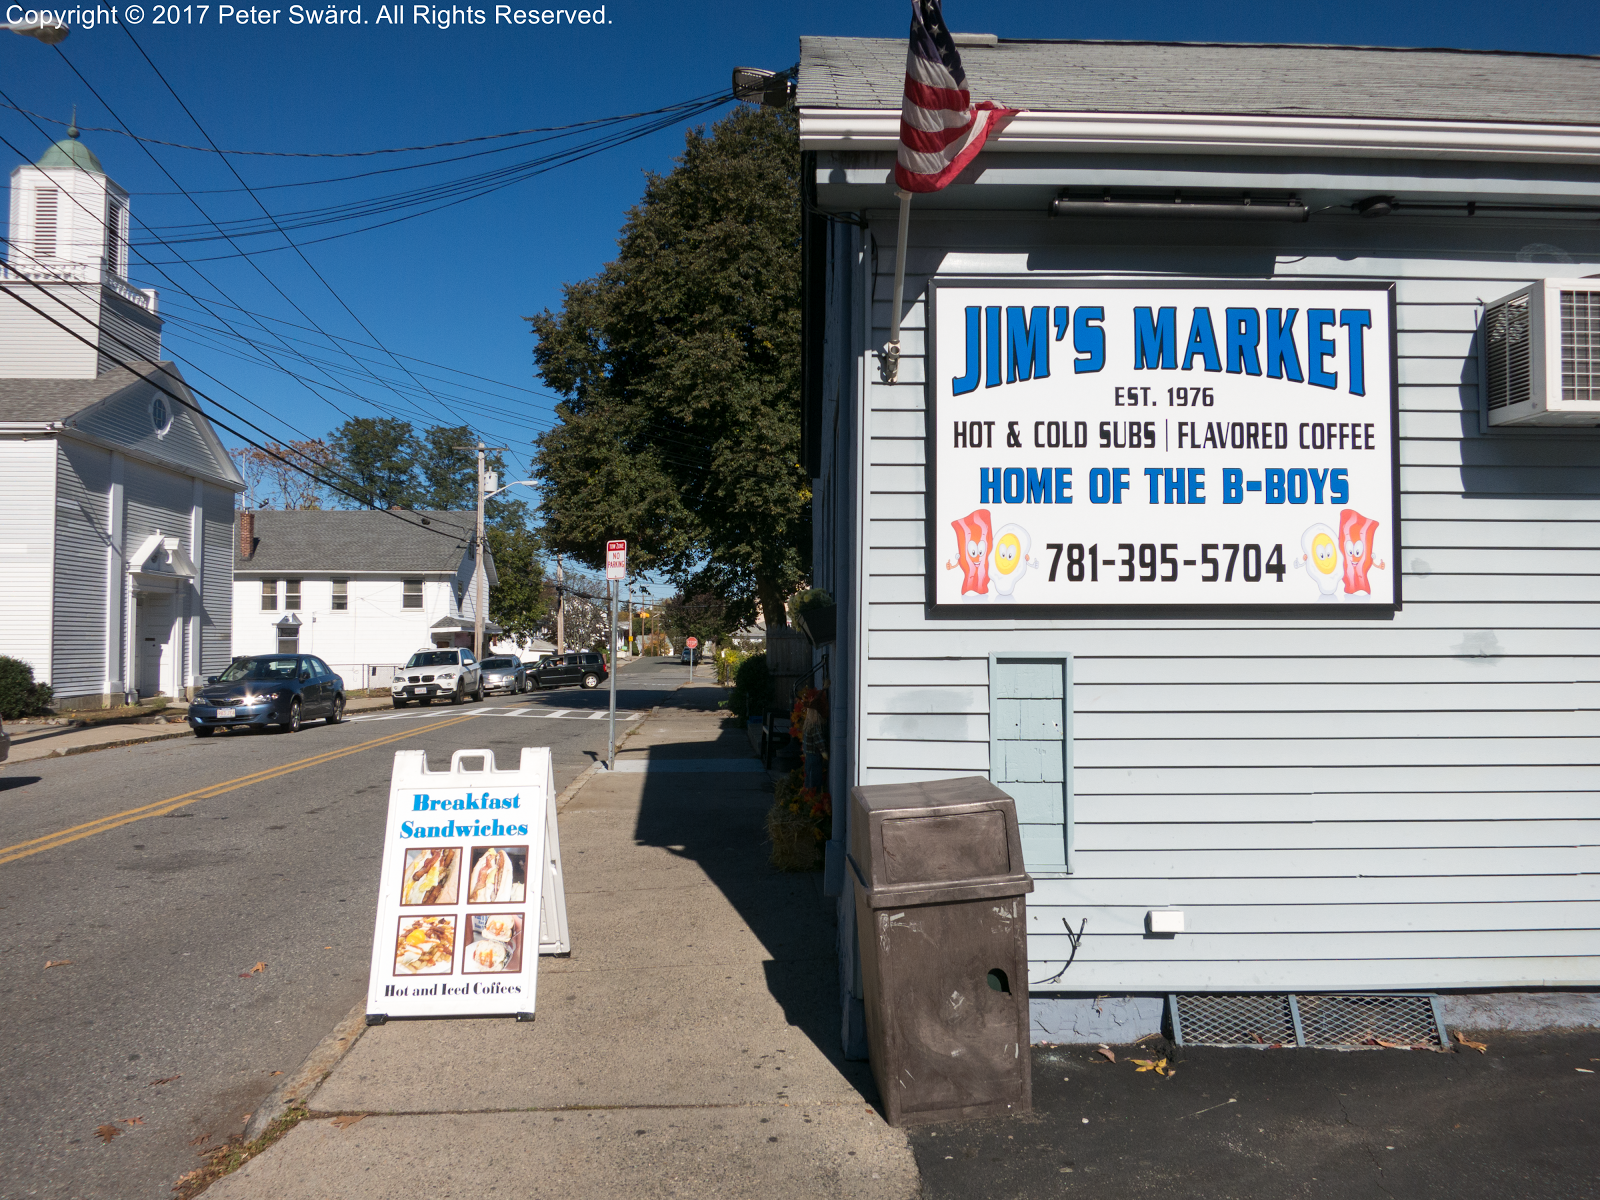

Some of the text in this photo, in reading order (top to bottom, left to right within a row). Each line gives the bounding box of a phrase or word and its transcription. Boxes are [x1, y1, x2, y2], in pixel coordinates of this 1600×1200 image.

[952, 305, 1372, 397] JIM'S MARKET
[1114, 386, 1214, 407] EST. 1976
[953, 420, 1156, 449] HOT & COLD SUBS
[1177, 421, 1376, 450] FLAVORED COFFEE
[979, 467, 1350, 505] HOME OF THE B-BOYS
[608, 560, 625, 568] PARKING
[612, 552, 621, 560] NO
[1046, 543, 1287, 583] 781-395-5704
[411, 792, 521, 811] Breakfast
[399, 818, 528, 839] Sandwiches
[384, 981, 522, 997] Hot and Iced Coffees
